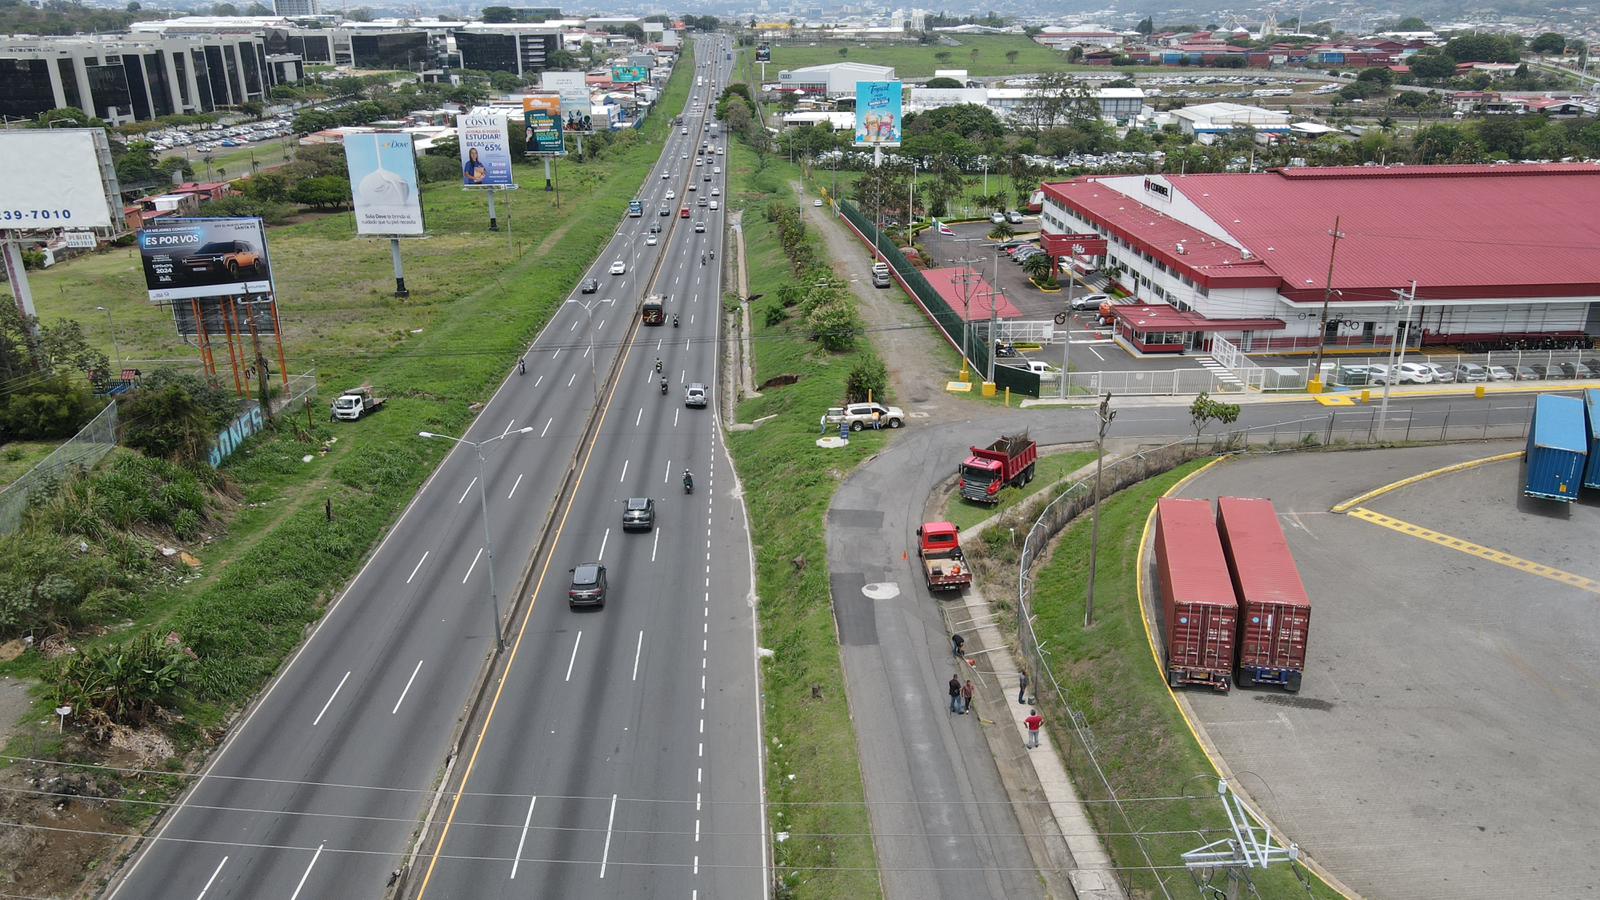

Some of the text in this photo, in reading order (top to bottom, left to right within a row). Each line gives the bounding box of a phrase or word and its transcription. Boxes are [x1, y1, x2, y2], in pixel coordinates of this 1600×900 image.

[391, 139, 409, 148] Dove
[484, 143, 502, 151] 65%
[0, 209, 71, 220] 39-7010
[145, 233, 199, 246] ES POR VOS
